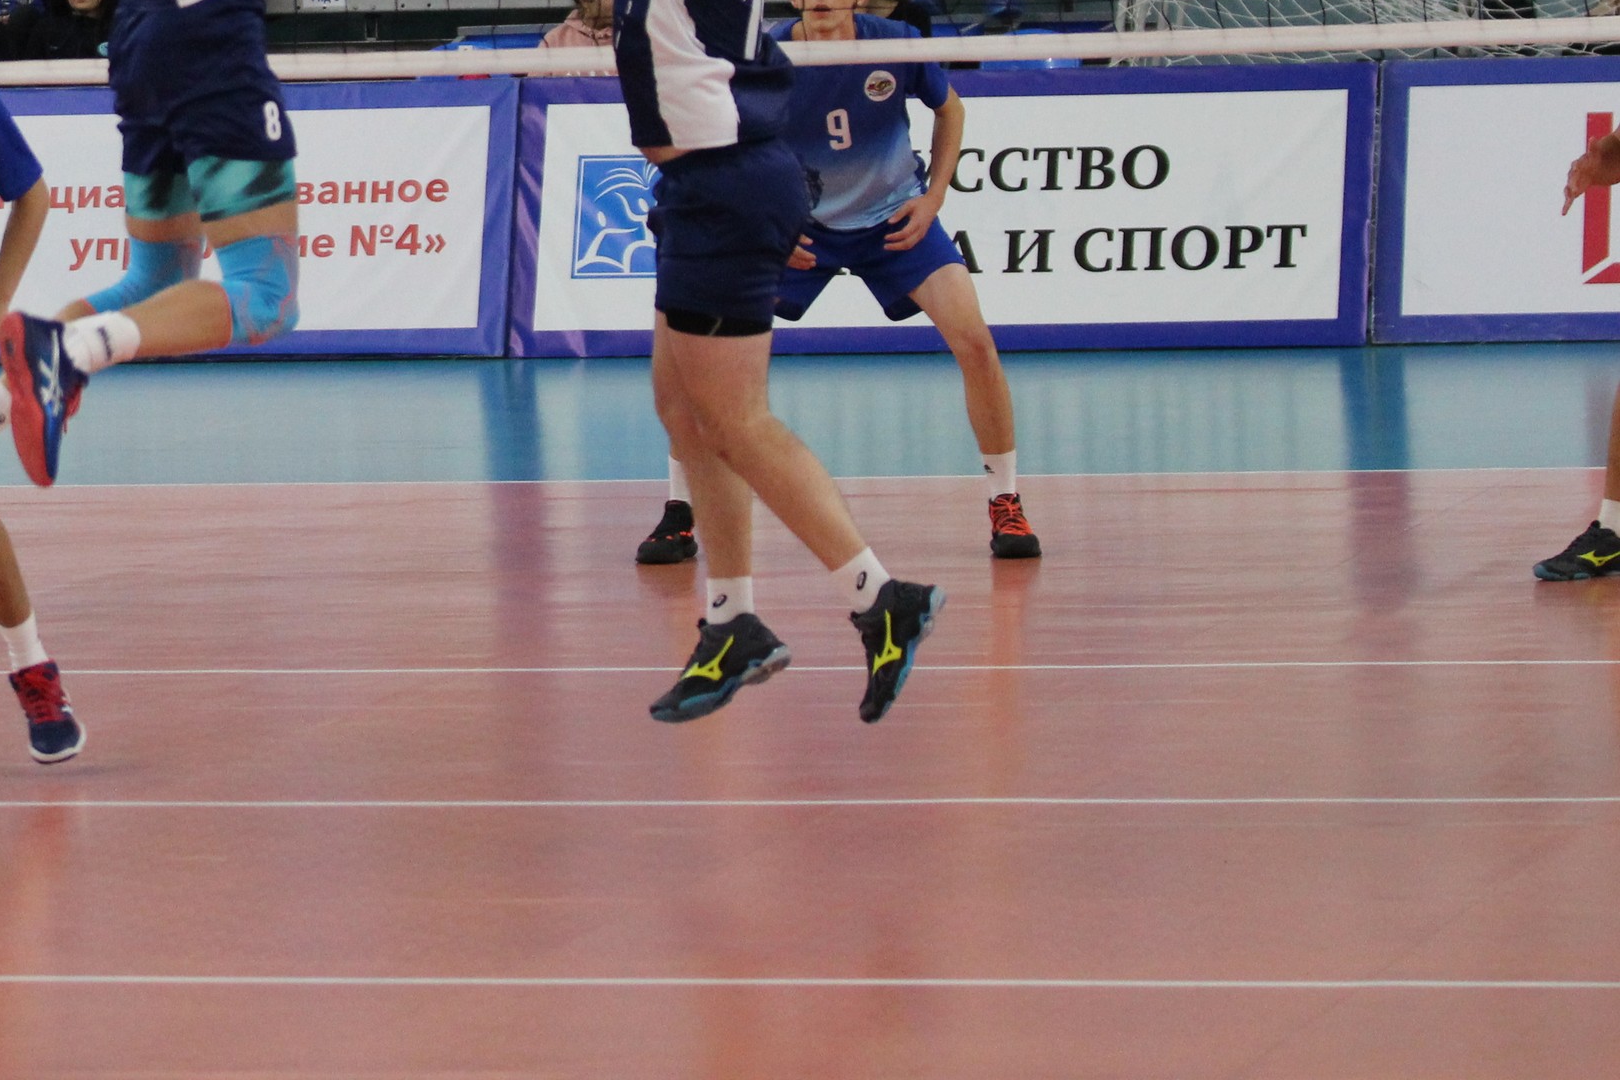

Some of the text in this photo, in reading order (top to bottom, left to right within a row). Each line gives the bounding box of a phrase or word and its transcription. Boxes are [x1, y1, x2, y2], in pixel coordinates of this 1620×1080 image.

[264, 100, 280, 141] 8
[826, 108, 852, 151] 9
[920, 144, 1170, 193] ССТВО
[350, 223, 446, 257] №4»
[1002, 229, 1056, 273] И
[1074, 224, 1308, 272] СПОРТ
